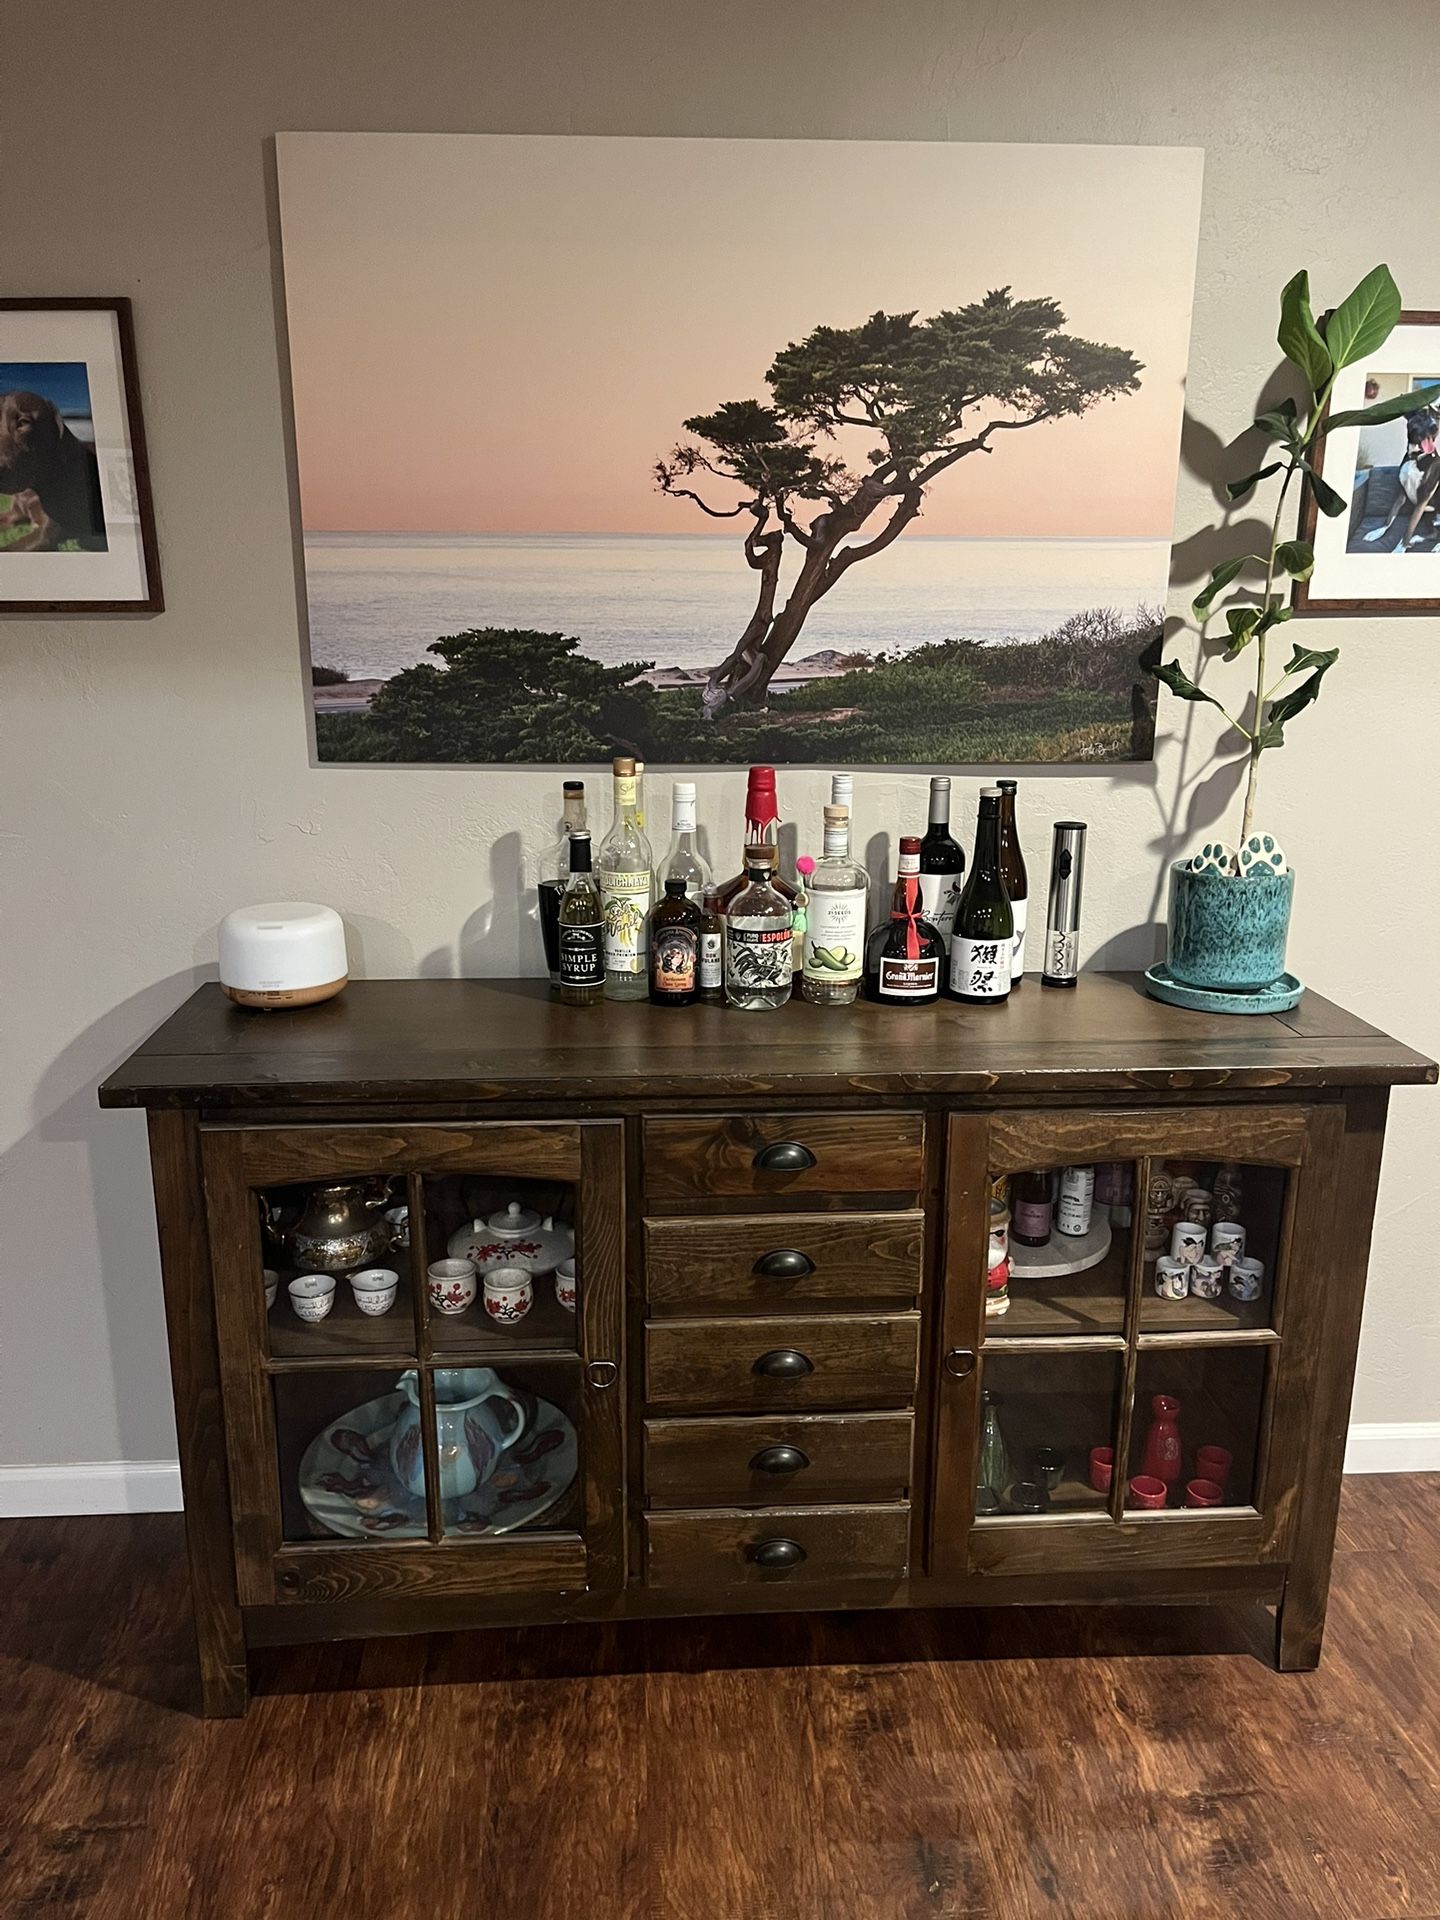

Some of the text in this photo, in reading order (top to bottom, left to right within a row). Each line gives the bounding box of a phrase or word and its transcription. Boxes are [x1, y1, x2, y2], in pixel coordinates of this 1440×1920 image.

[561, 954, 598, 963] SIMPLE
[562, 963, 596, 972] SYRUP
[886, 970, 934, 981] Grand Marnier
